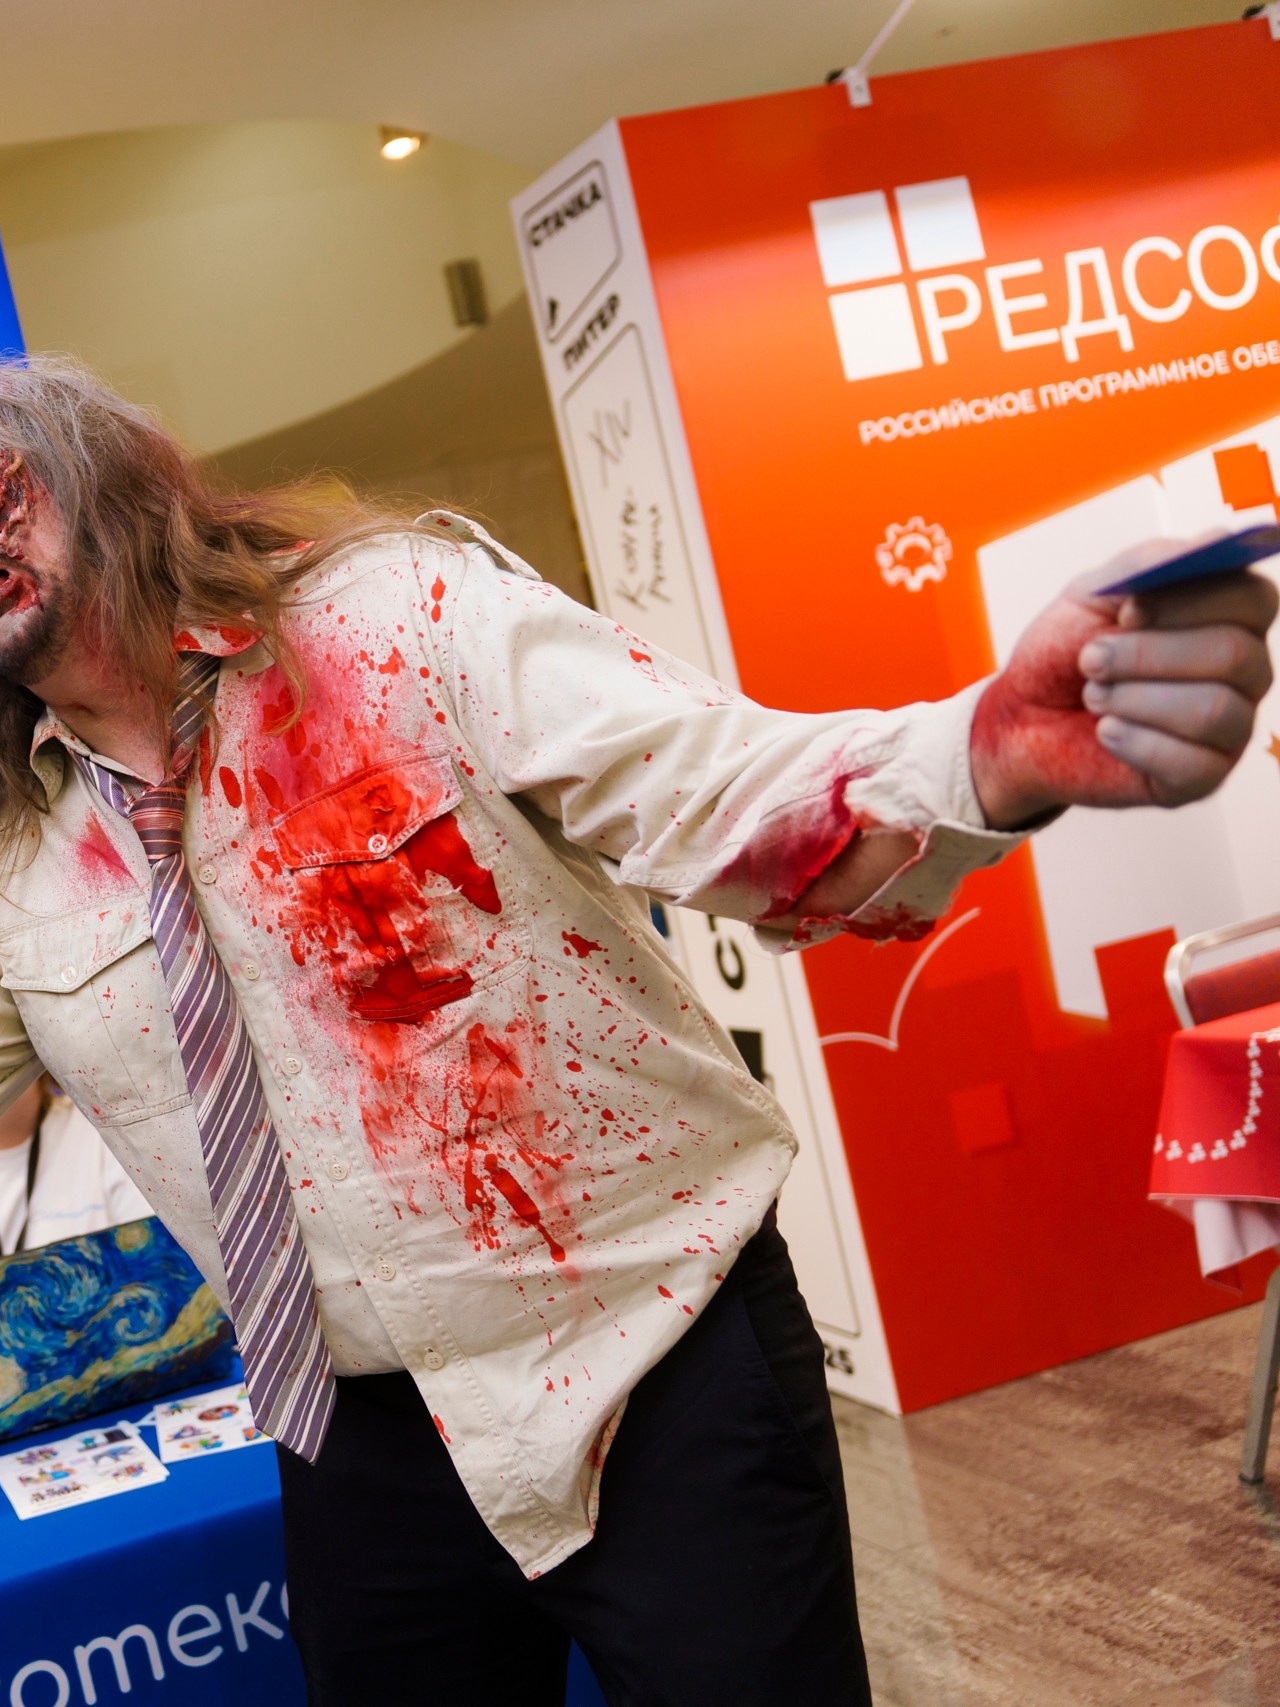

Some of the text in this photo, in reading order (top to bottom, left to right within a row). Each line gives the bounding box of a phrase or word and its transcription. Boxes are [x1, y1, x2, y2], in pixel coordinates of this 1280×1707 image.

[528, 181, 604, 249] СТАЧКА
[563, 293, 620, 372] ПИТЕР
[859, 340, 1280, 446] РОССИЙСКОЕ ПРОГРАММНОЕ ОБЕ
